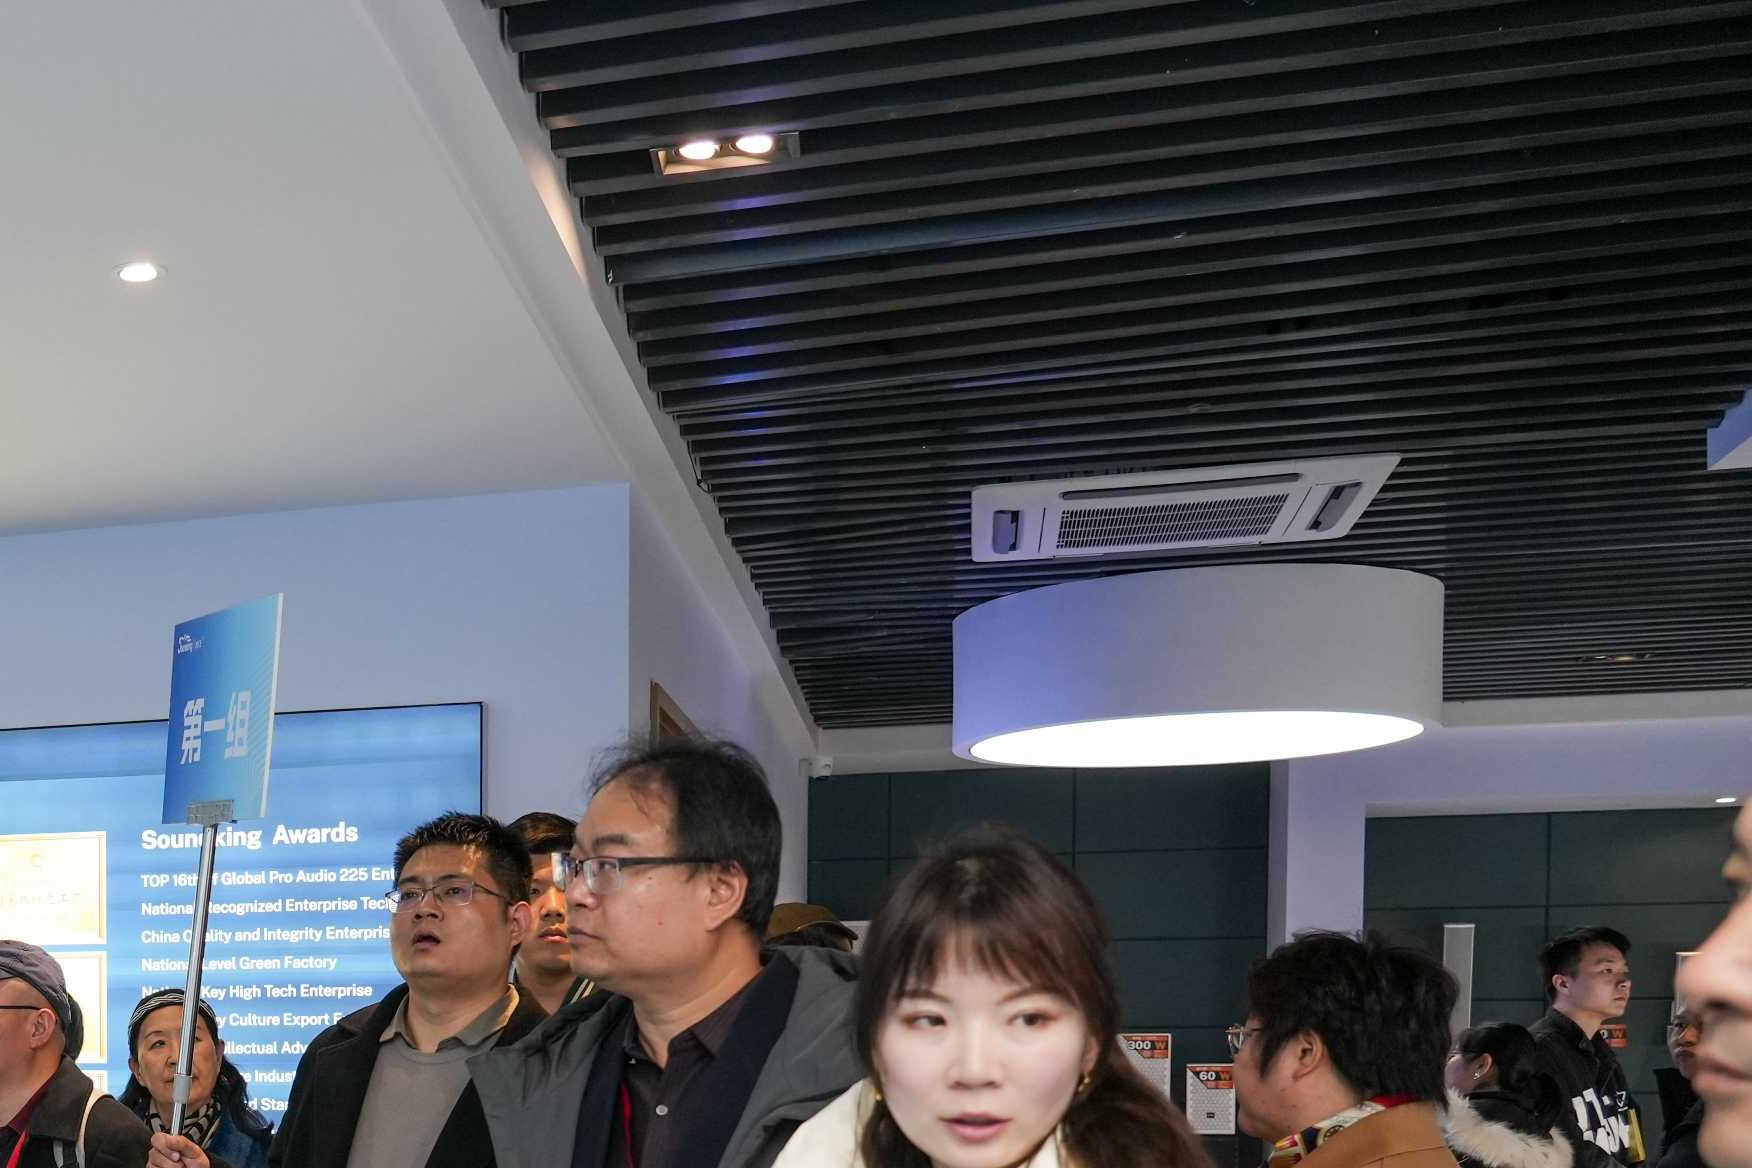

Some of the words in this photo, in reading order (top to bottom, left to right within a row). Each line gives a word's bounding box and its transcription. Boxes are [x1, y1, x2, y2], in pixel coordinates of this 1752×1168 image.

[180, 688, 252, 766] 第一组
[272, 821, 359, 845] Awards
[140, 873, 170, 888] TOP
[221, 870, 266, 886] Global
[269, 869, 293, 885] Pro
[296, 868, 337, 883] Audio
[339, 867, 369, 882] 225
[285, 898, 358, 913] Enterprise
[141, 930, 181, 944] China
[234, 928, 261, 942] and
[263, 926, 323, 943] Integrity
[239, 956, 281, 971] Green
[284, 955, 338, 971] Factory
[200, 985, 227, 999] Key
[229, 984, 262, 1000] High
[264, 984, 297, 998] Tech
[300, 983, 373, 999] Enterprise
[229, 1012, 281, 1027] Culture
[283, 1012, 330, 1028] Export
[1612, 1030, 1625, 1039] W
[1128, 1040, 1151, 1050] 300
[1199, 1071, 1216, 1081] 60
